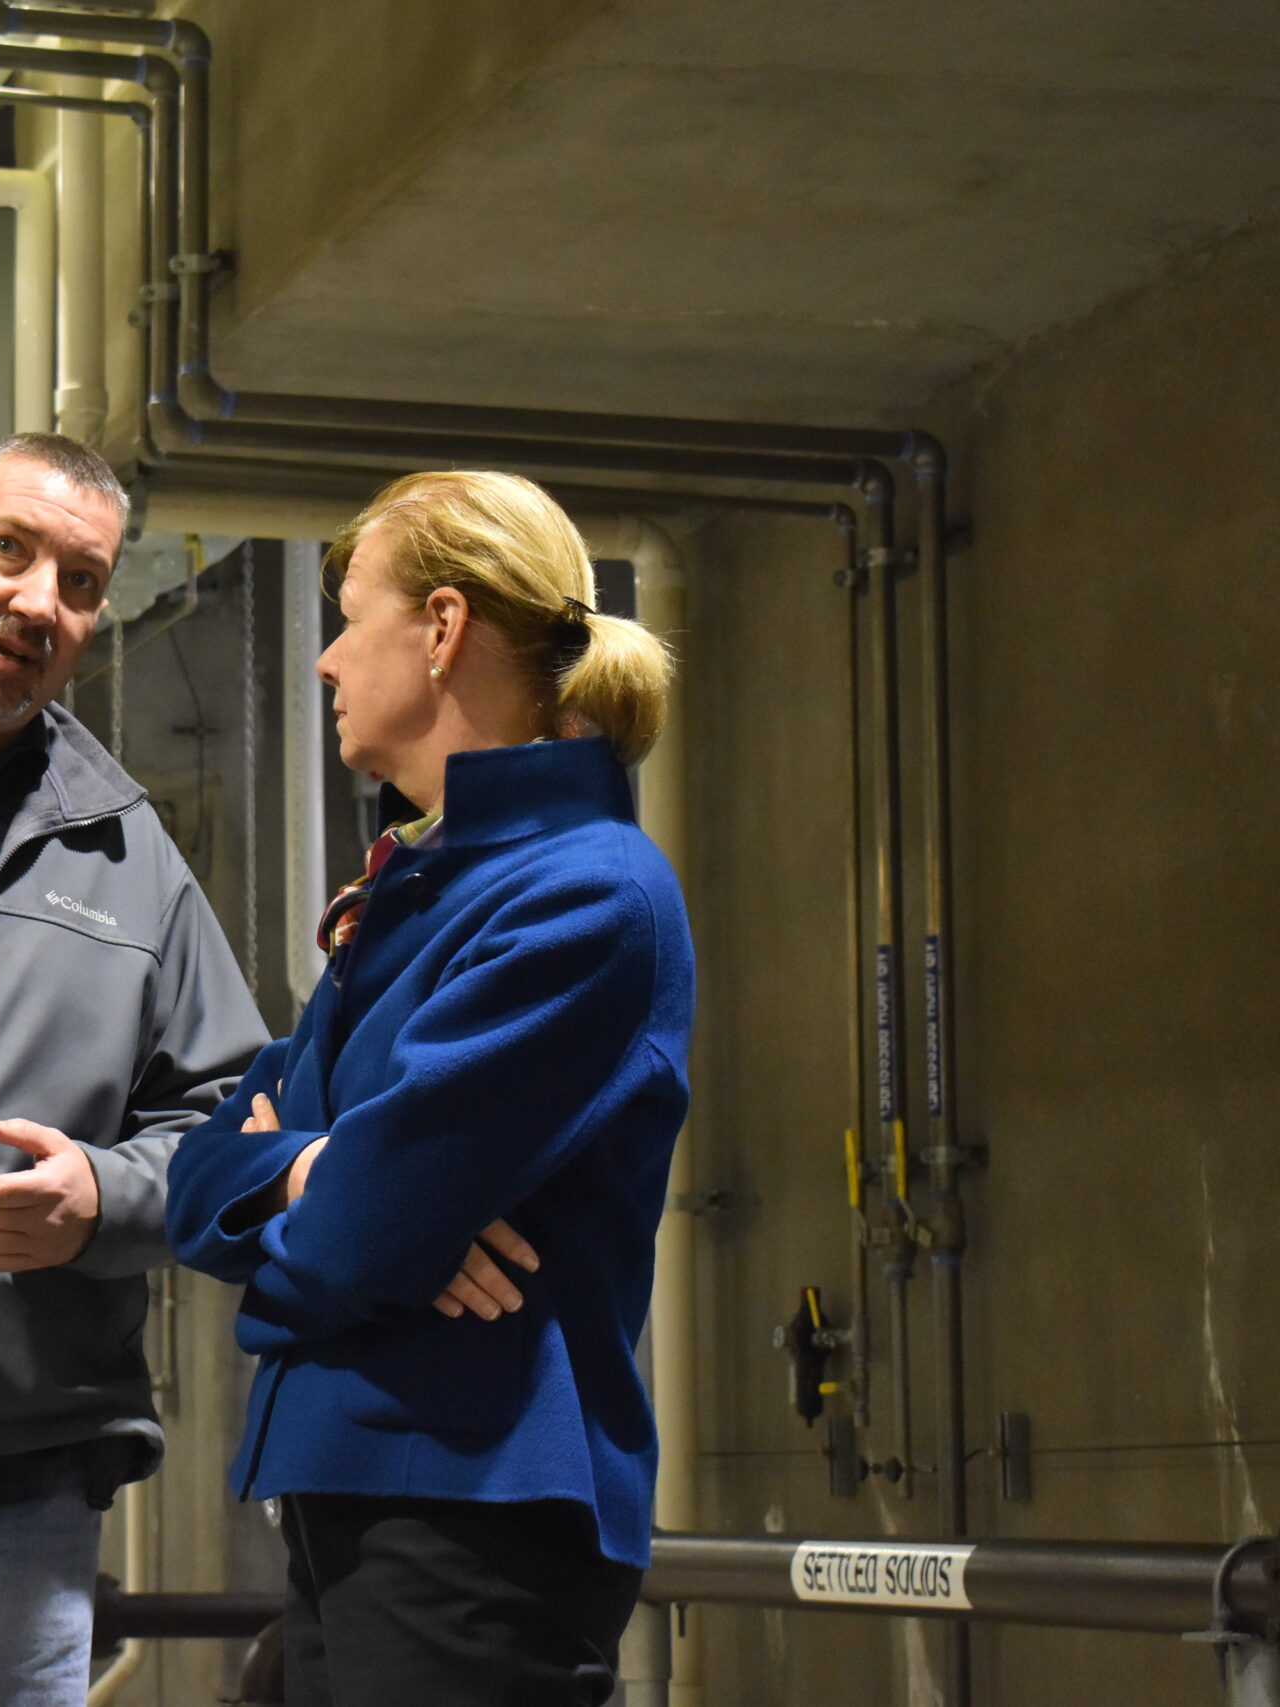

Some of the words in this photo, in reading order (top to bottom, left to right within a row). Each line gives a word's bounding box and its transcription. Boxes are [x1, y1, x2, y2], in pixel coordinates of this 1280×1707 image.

[60, 895, 117, 926] Columbia
[803, 1552, 878, 1594] SETTLED
[884, 1554, 952, 1598] SOLIDS
